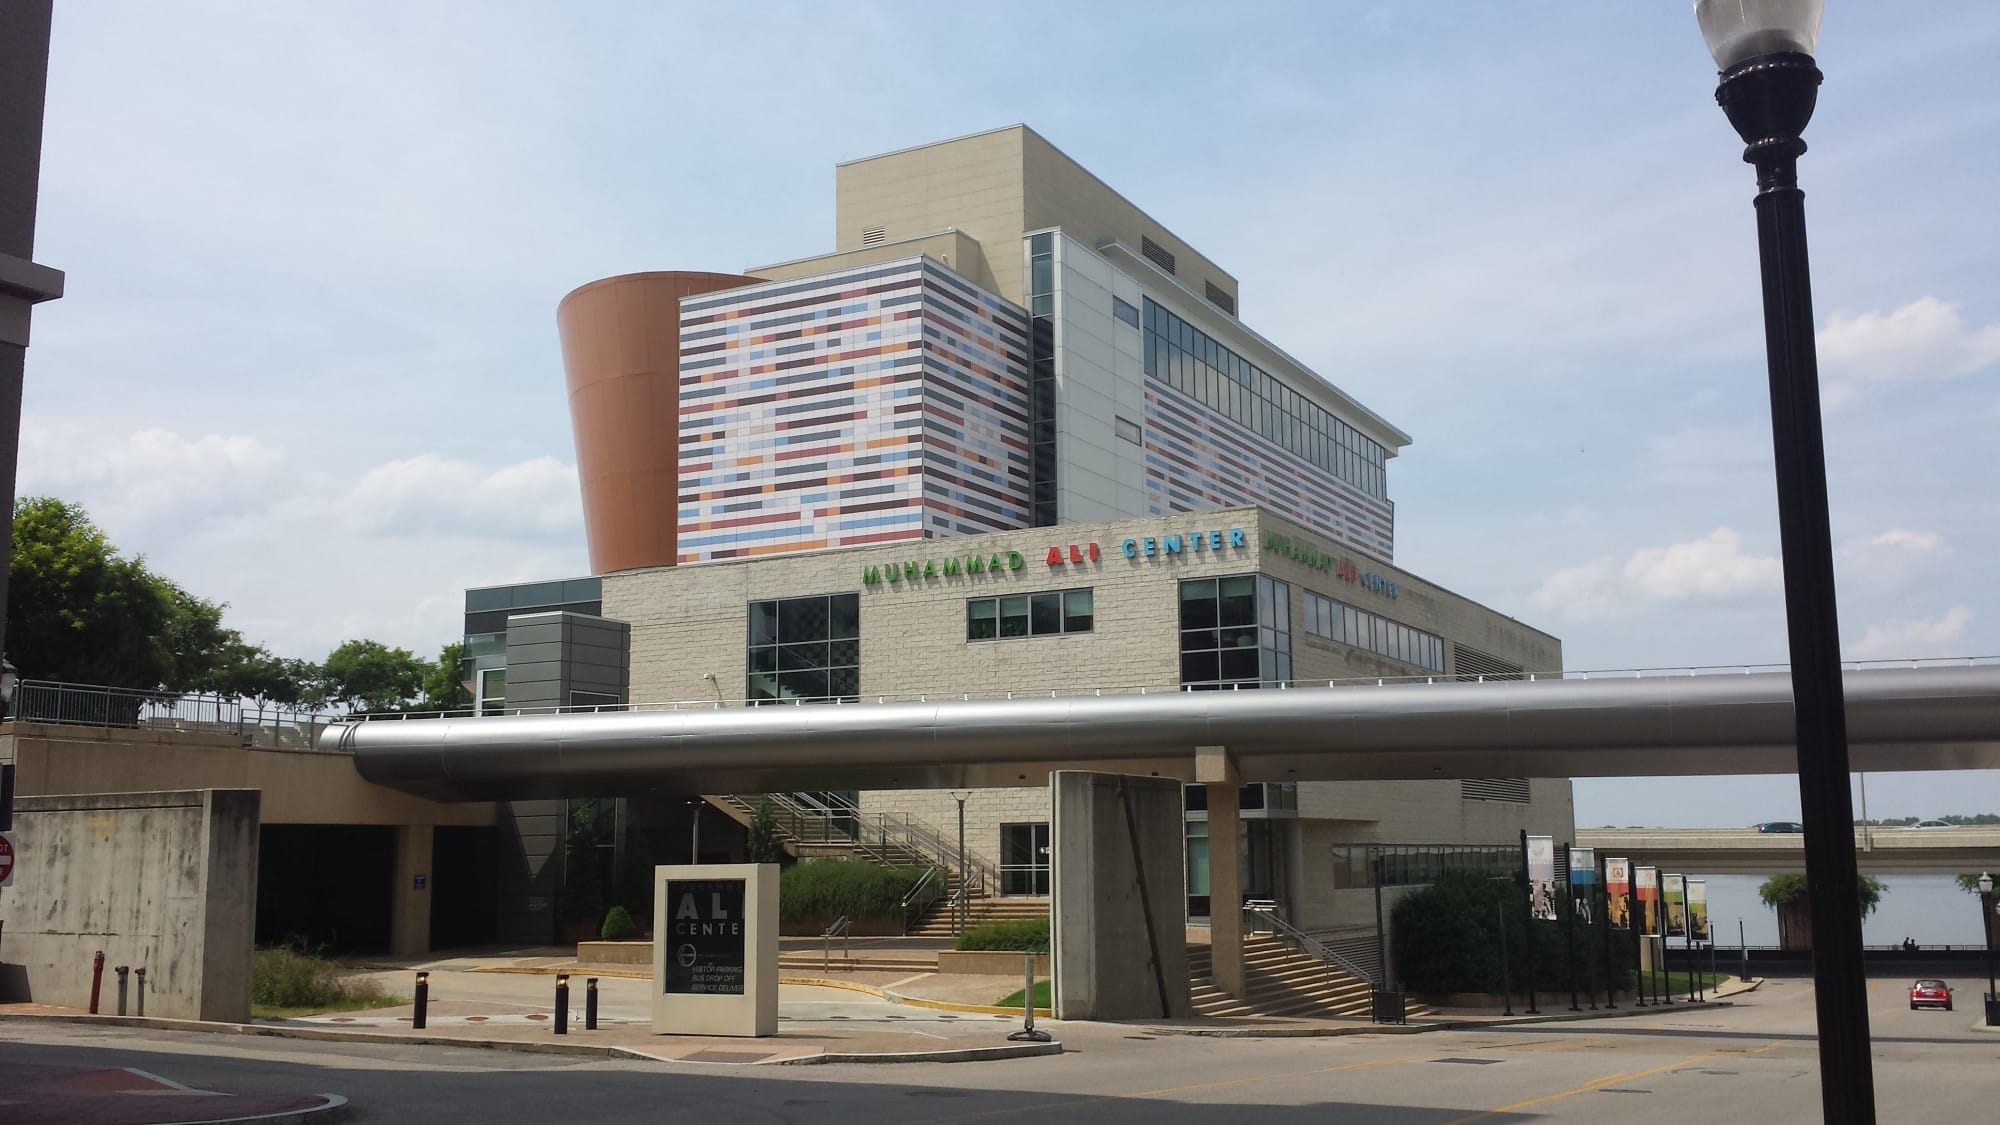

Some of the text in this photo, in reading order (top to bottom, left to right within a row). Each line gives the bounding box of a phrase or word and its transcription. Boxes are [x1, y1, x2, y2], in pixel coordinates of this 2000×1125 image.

[863, 527, 1245, 584] MUHAMMAD ALI CENTER
[692, 974, 737, 982] BUS DROP OFF
[691, 983, 717, 991] SERVICE
